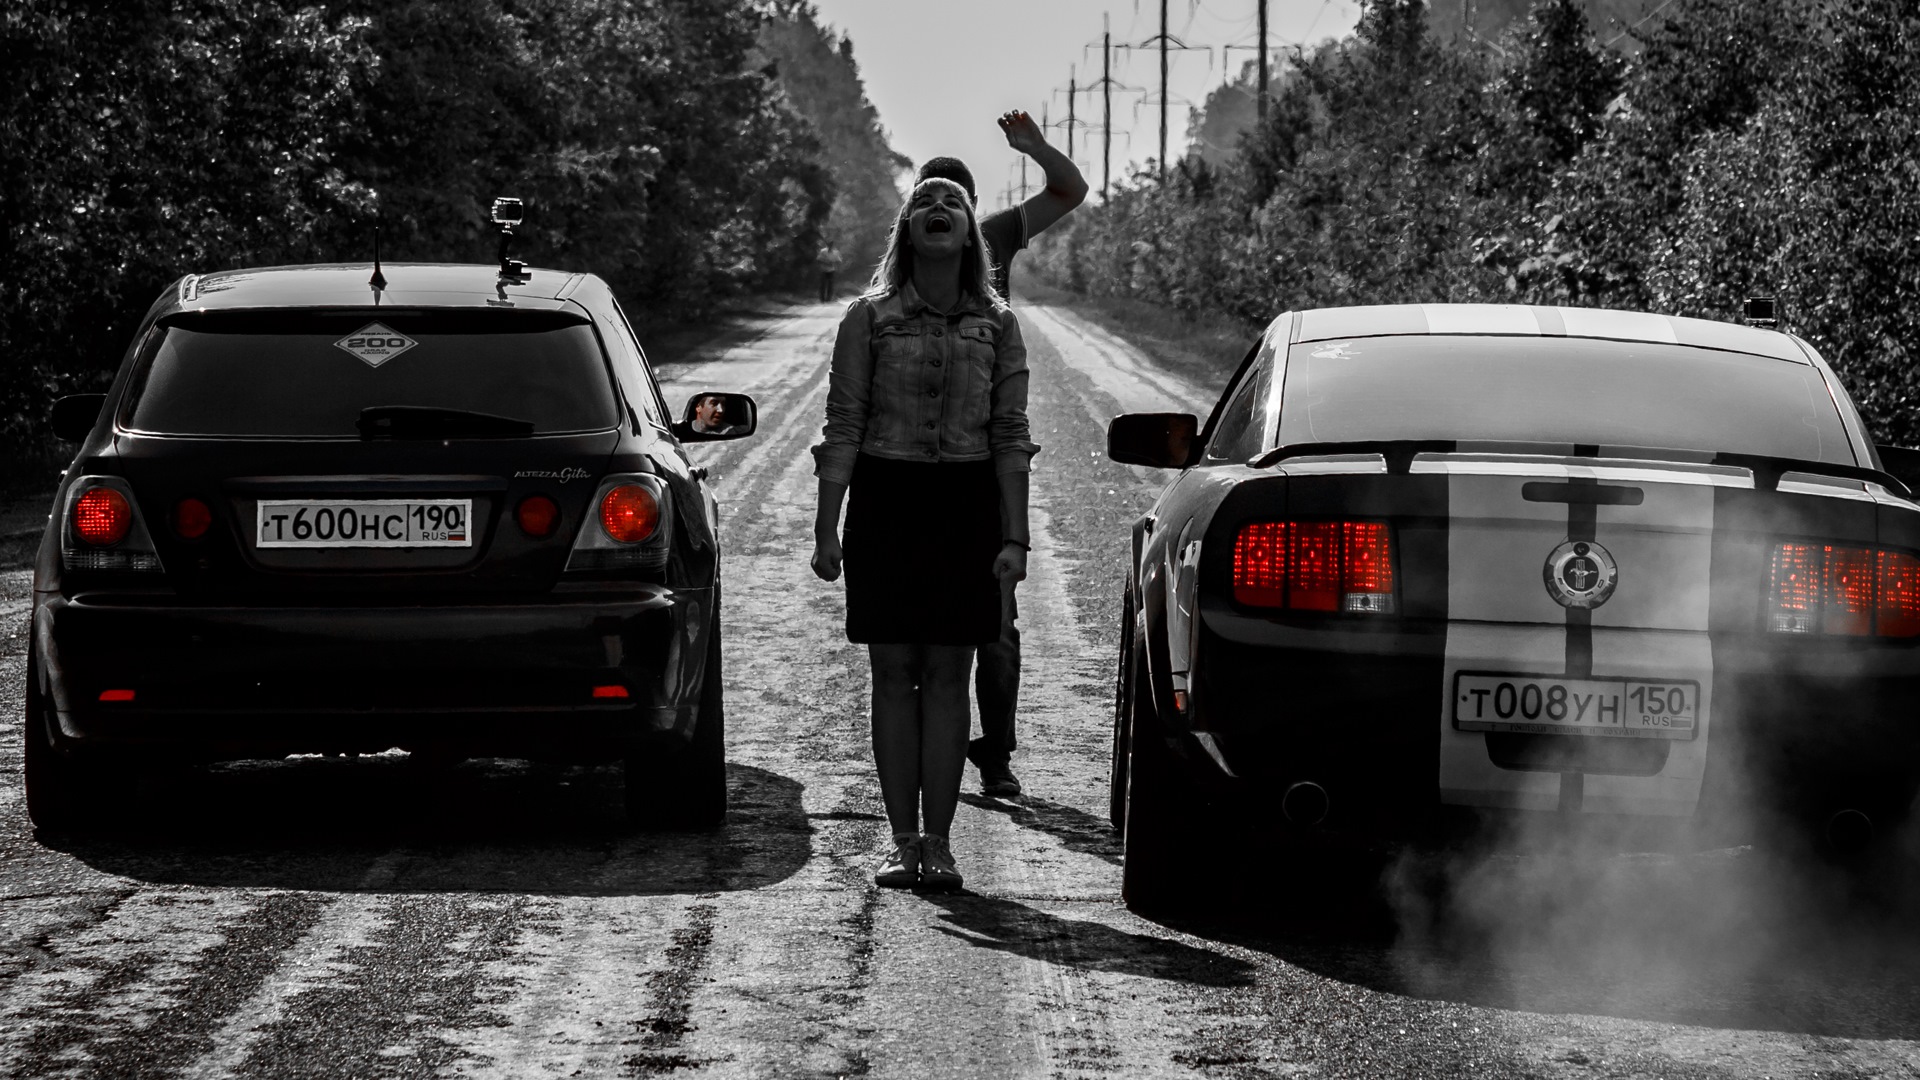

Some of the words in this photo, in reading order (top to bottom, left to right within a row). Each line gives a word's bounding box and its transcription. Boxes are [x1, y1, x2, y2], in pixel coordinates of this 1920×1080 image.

[347, 337, 405, 348] 200
[514, 470, 560, 478] ALTEZZA
[560, 467, 591, 484] Gita
[412, 505, 461, 530] 190
[422, 531, 447, 541] RUS
[1630, 685, 1685, 715] 150
[1642, 715, 1670, 727] RUS
